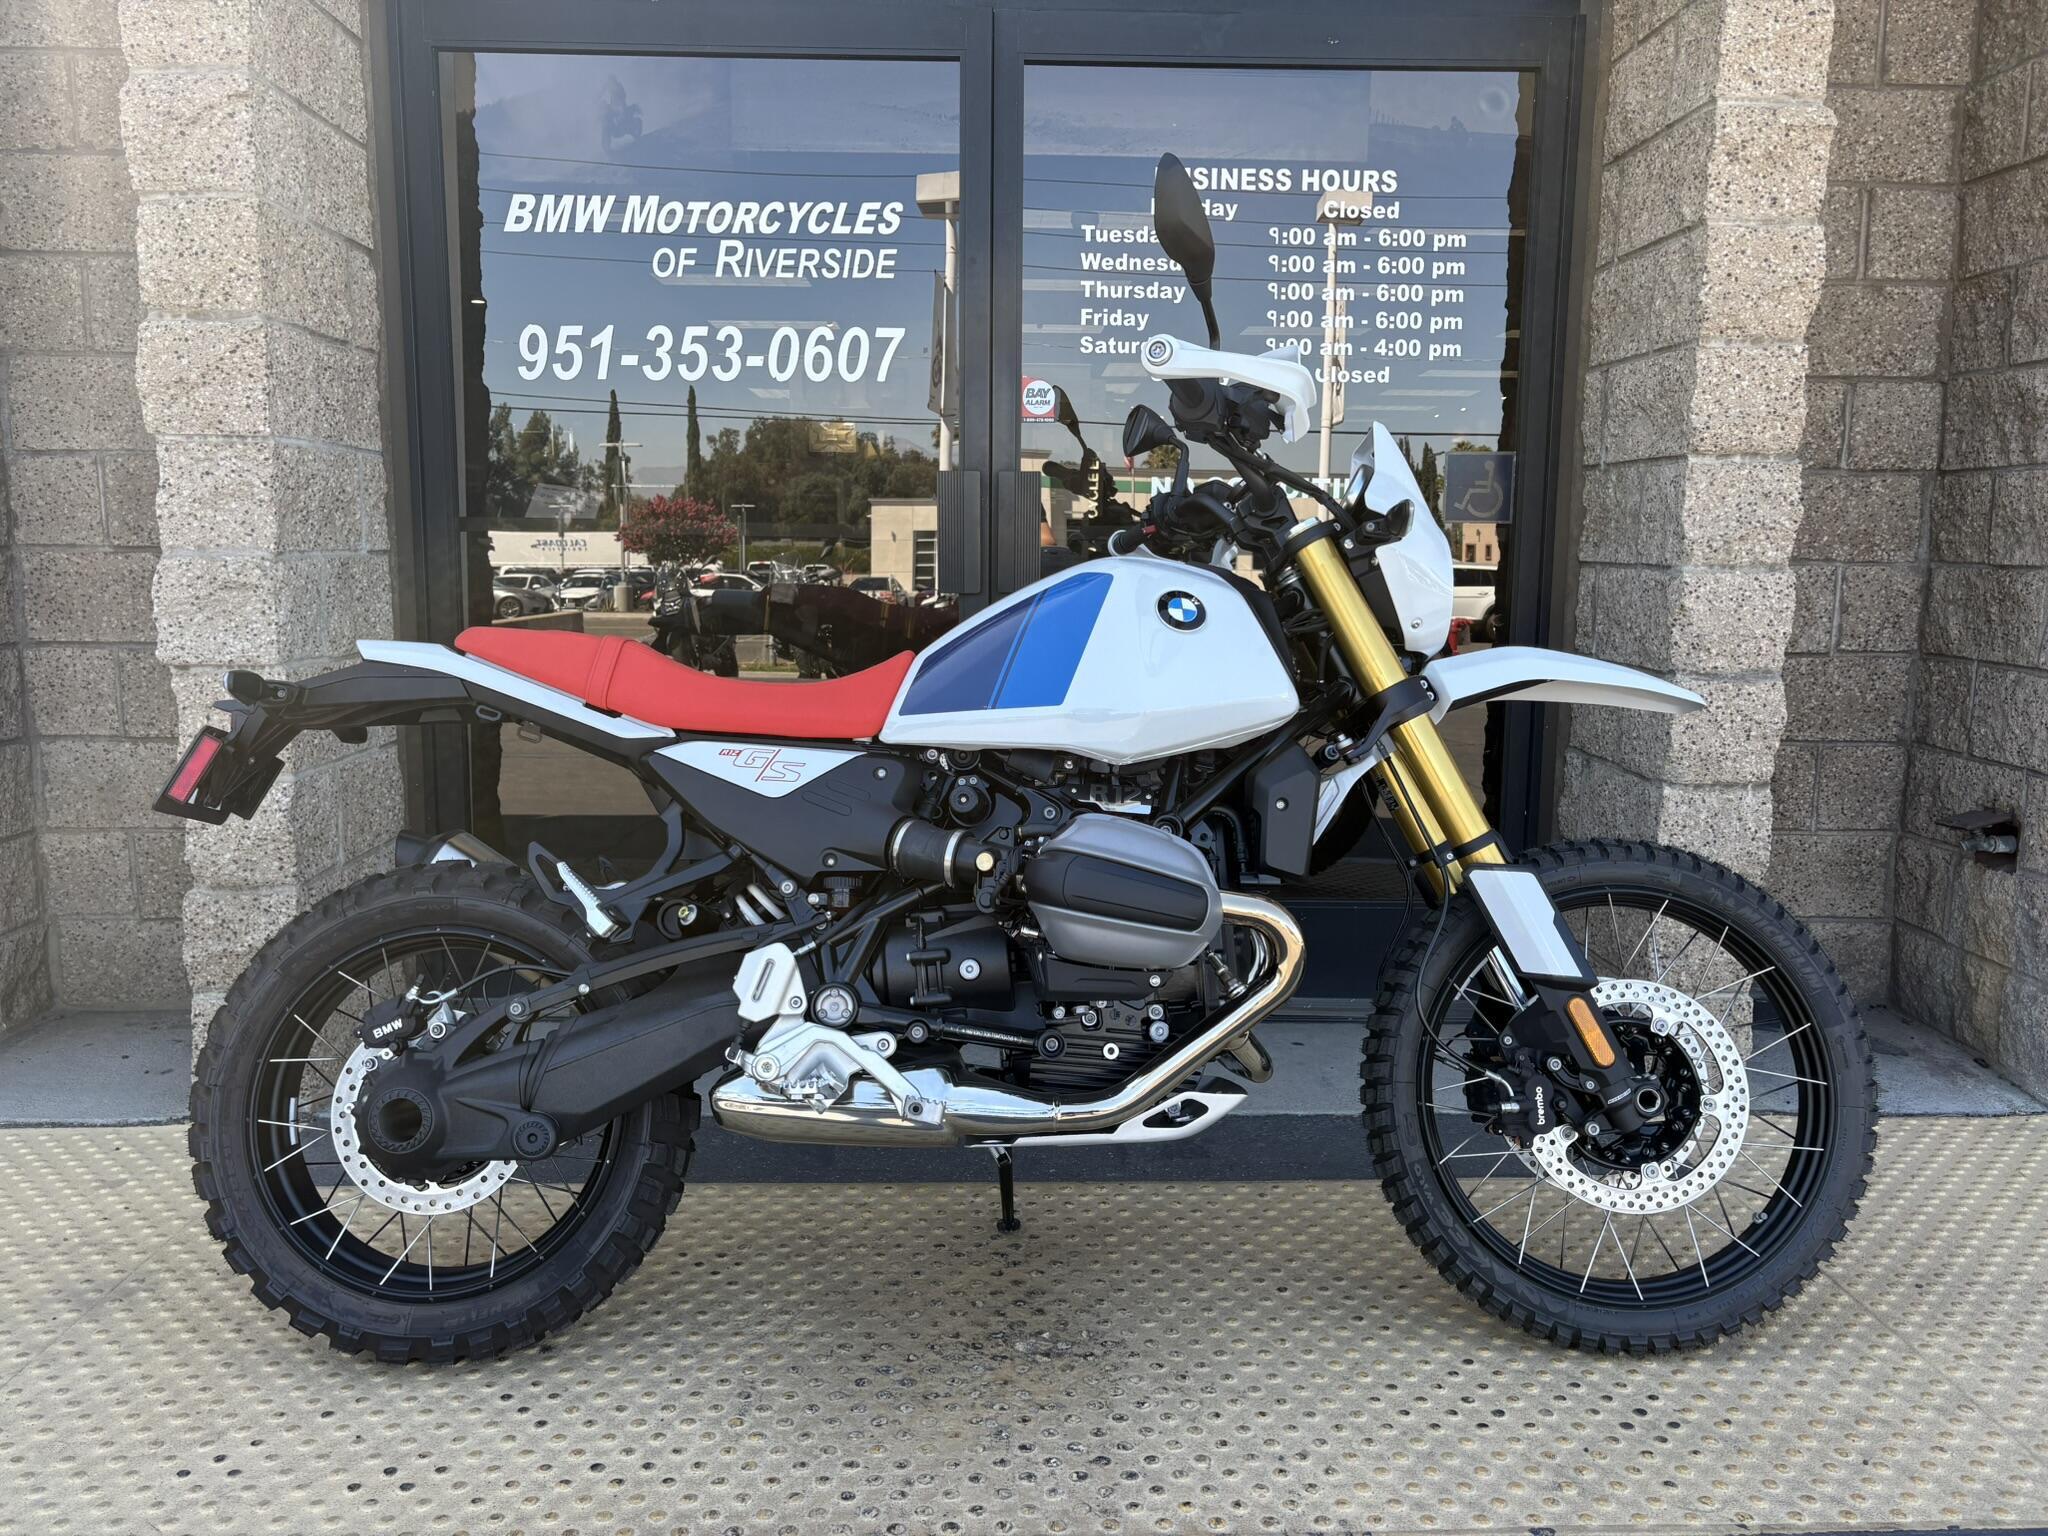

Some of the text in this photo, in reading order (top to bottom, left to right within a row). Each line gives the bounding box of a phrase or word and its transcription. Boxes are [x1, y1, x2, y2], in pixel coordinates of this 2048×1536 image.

[1155, 167, 1398, 193] SINESS HOURS
[503, 193, 904, 235] BMW MOTORCYCLES
[1151, 198, 1400, 221] day Closed
[1080, 224, 1161, 243] Tuesda
[1268, 227, 1316, 246] 9:00
[1323, 232, 1357, 246] am
[1378, 229, 1426, 247] 6:00
[1433, 232, 1467, 251] pm
[652, 239, 898, 279] OF RIVERSIDE
[1080, 252, 1185, 271] Wednesd
[1268, 254, 1315, 273] 9:00
[1322, 260, 1356, 274] am
[1377, 256, 1425, 275] 6:00
[1431, 260, 1466, 279] pm
[1080, 280, 1186, 304] Thursday
[1267, 282, 1314, 300] 9:00
[1321, 287, 1355, 301] am
[1376, 284, 1424, 302] 6:00
[1430, 288, 1464, 307] pm
[1080, 308, 1150, 331] Friday
[1266, 310, 1313, 328] 9:00
[1320, 314, 1354, 329] am
[1375, 311, 1423, 330] 6:00
[1429, 315, 1463, 334] pm
[516, 323, 907, 383] 951-353-0607
[1079, 335, 1147, 354] Satur
[1319, 342, 1353, 356] am
[1373, 338, 1421, 357] 4:00
[1428, 342, 1462, 361] pm
[1025, 387, 1051, 399] BAY
[1087, 473, 1099, 519] CYCLE
[372, 1018, 403, 1039] BMW
[1535, 1086, 1546, 1125] brembo
